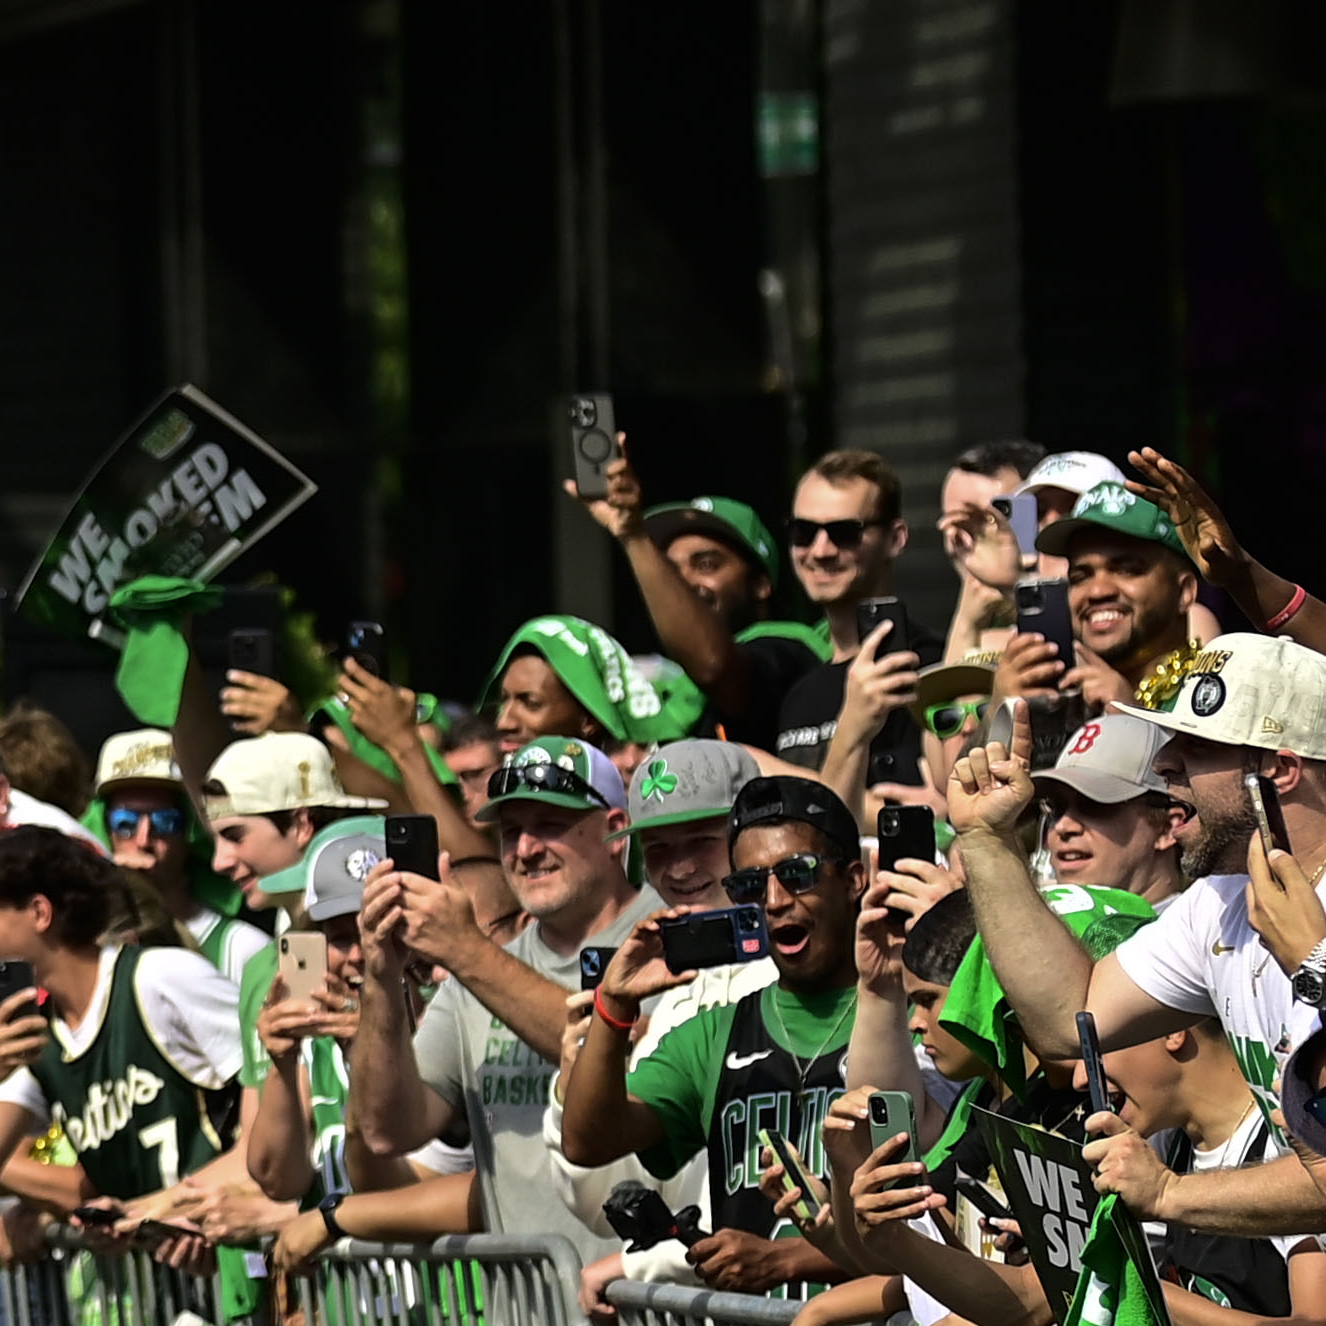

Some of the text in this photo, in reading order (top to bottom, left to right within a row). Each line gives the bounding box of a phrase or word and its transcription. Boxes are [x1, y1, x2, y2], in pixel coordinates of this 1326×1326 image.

[1067, 723, 1101, 755] B
[138, 1116, 179, 1189] 7
[1013, 1149, 1089, 1223] WE
